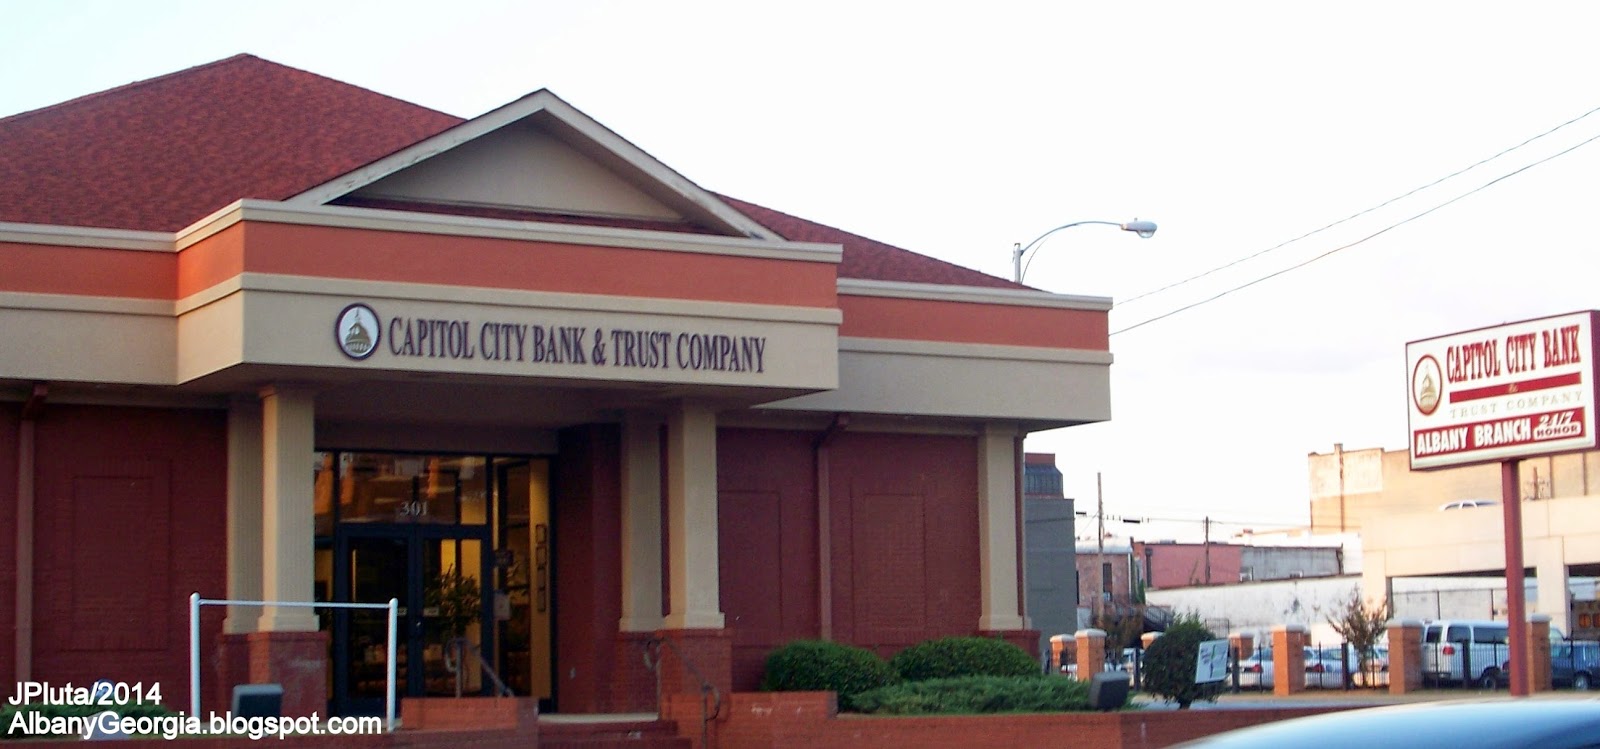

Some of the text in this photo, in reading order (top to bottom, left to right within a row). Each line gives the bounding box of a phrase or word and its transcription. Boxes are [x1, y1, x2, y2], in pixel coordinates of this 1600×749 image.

[389, 317, 766, 373] CAPITOL CITY BANK & TRUST COMPANY
[1446, 324, 1581, 384] CAPITOL CITY BANK
[1450, 391, 1582, 419] TRUST COMPANY
[1537, 425, 1578, 437] HONOR
[1538, 411, 1575, 428] 24/7
[1416, 417, 1531, 455] ALBANY BRANCH
[400, 501, 428, 516] 301
